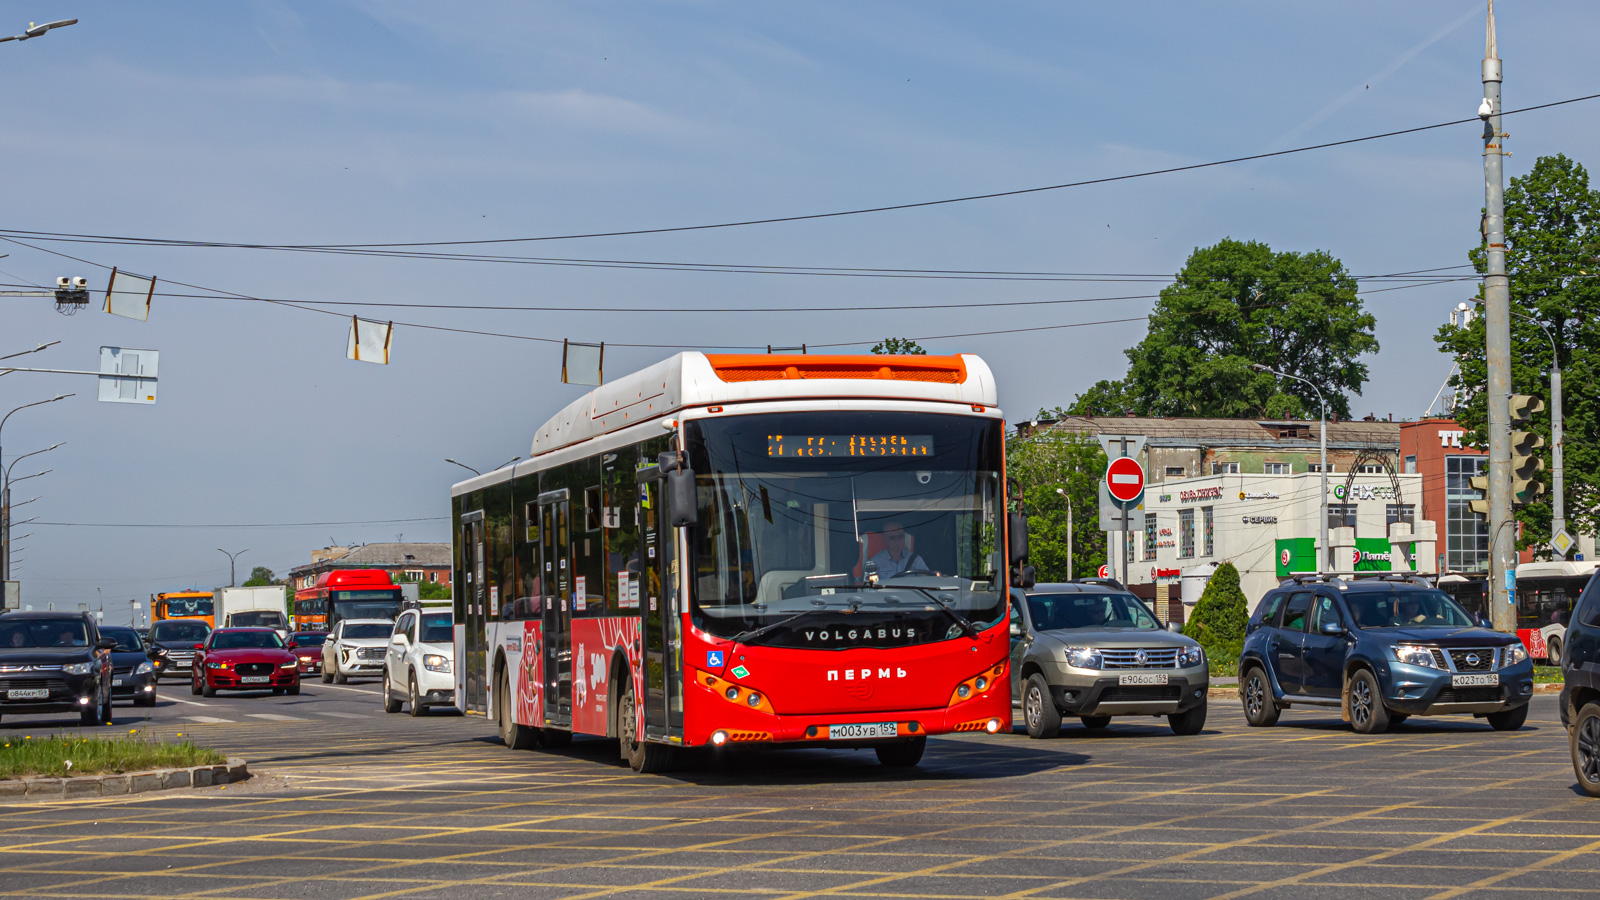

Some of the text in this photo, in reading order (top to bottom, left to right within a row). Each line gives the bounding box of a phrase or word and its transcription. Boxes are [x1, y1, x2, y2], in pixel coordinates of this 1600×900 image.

[1250, 516, 1277, 524] СЕРВИС
[805, 628, 915, 640] VOLGABUS
[827, 667, 907, 681] ПЕРМЬ
[832, 723, 894, 737] М003УВ 159
